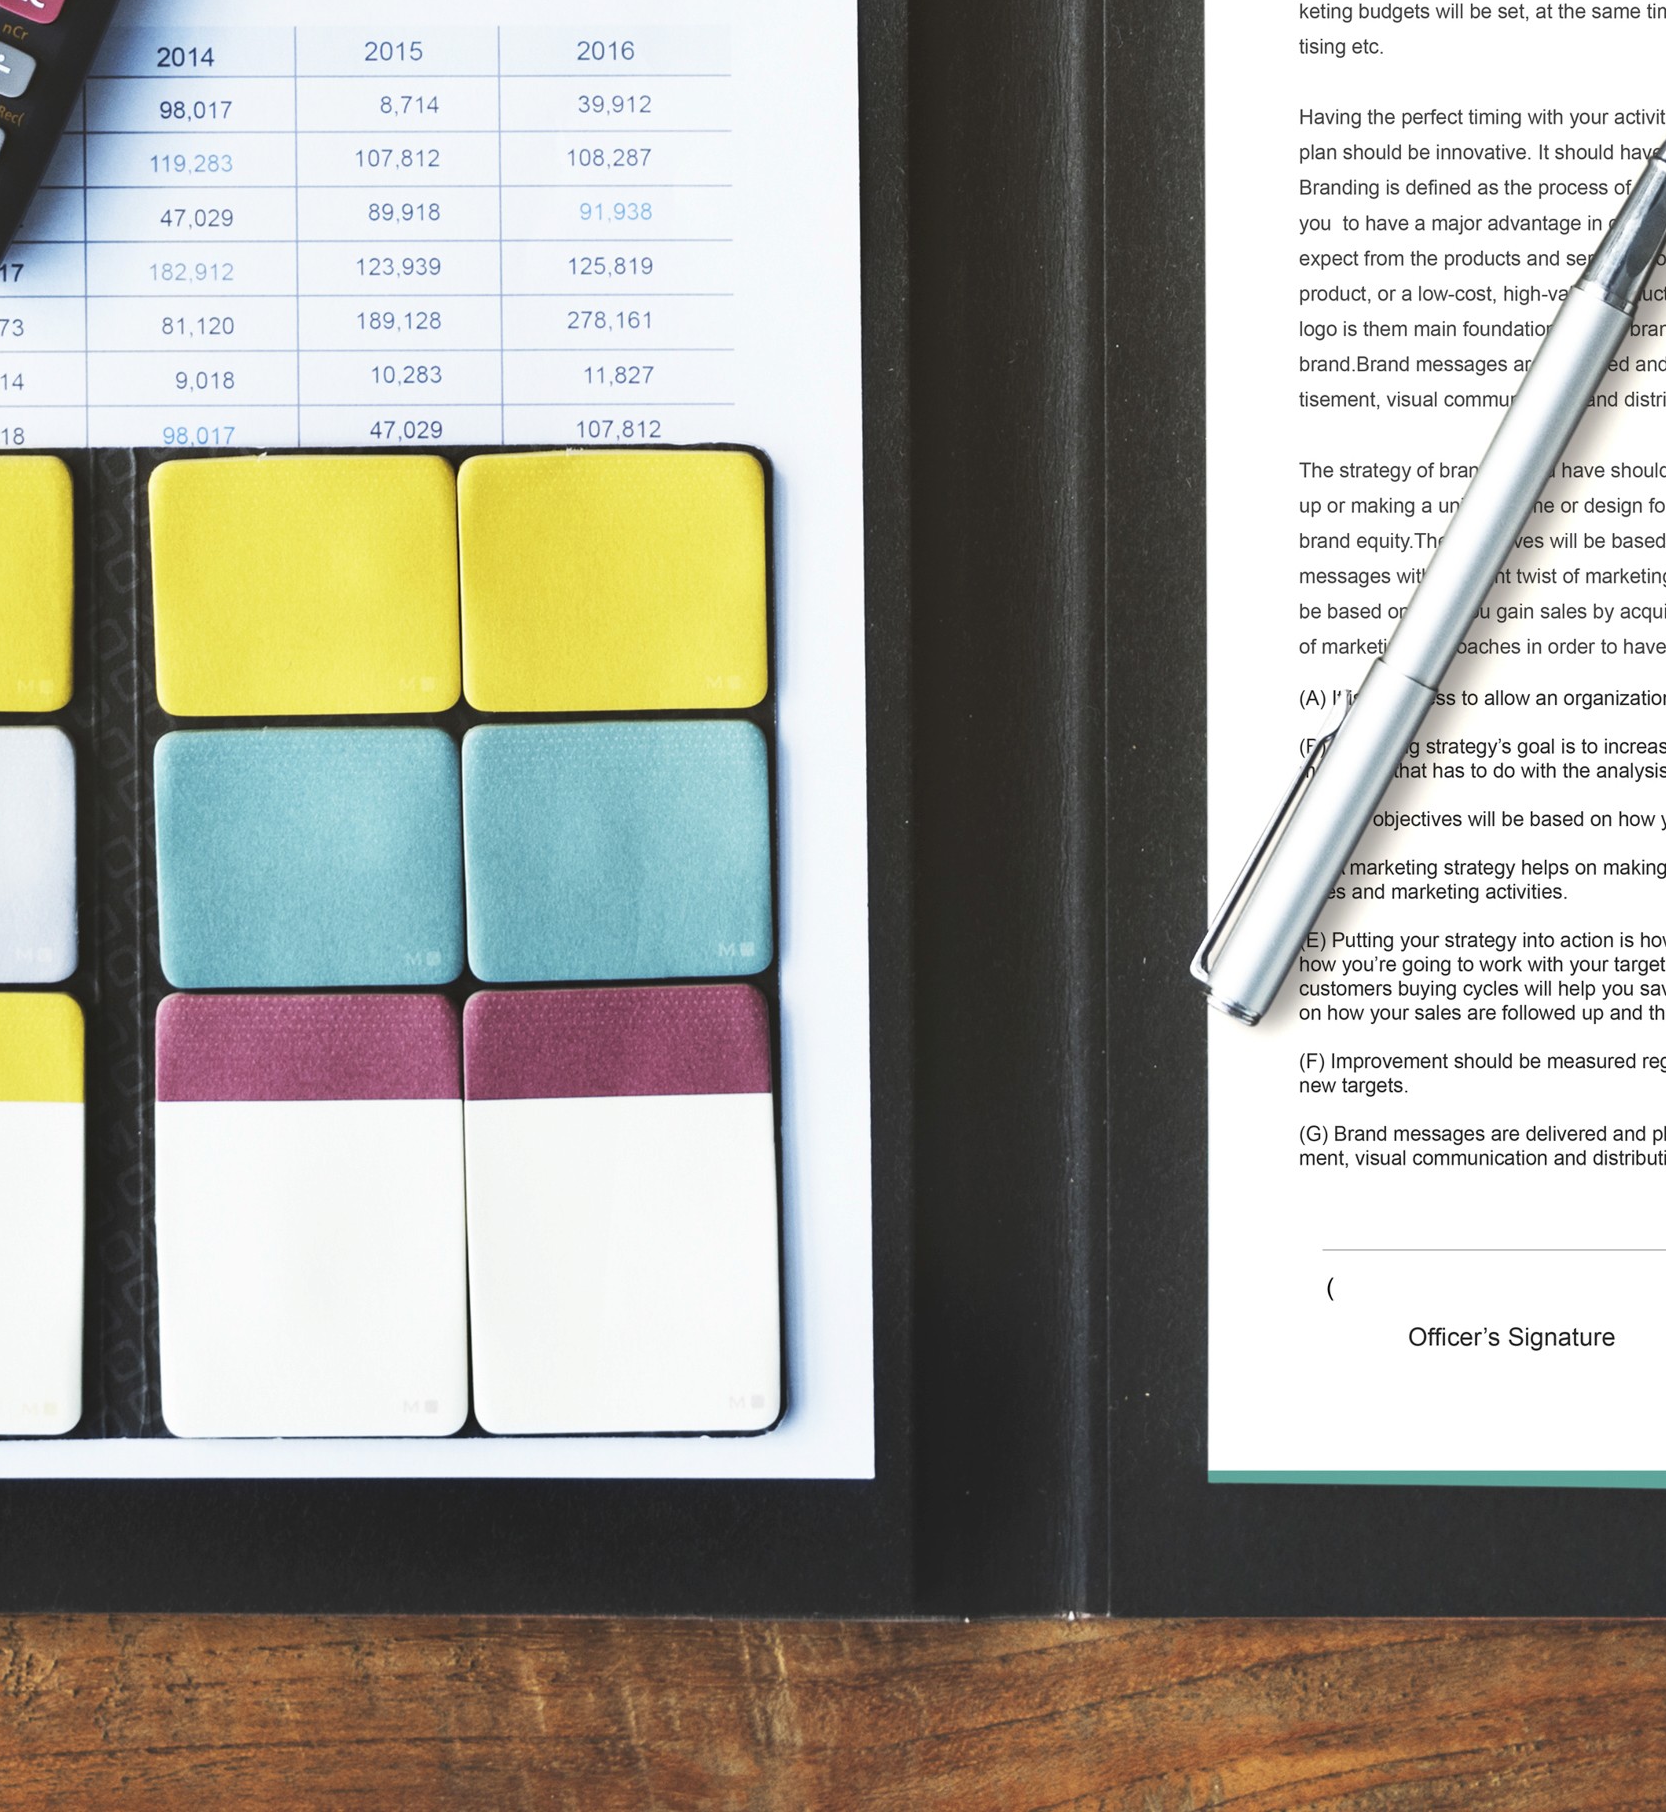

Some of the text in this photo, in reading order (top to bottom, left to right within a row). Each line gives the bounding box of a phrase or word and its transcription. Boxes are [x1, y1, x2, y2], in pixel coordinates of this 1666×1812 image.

[157, 40, 635, 67] 2014 2015 2016
[159, 95, 651, 122] 98,017 8,714 39,912
[150, 154, 234, 175] 119,283
[356, 149, 440, 170] 107,812
[567, 148, 651, 169] 108,287
[160, 209, 234, 230] 47,029
[368, 202, 440, 224] 89,918
[580, 202, 652, 224] 91,938
[150, 263, 235, 284] 182,912
[356, 257, 441, 278] 123,939
[568, 256, 653, 277] 125,819
[162, 317, 235, 338] 81,120
[357, 311, 442, 332] 189,128
[567, 311, 652, 332] 278,161
[175, 371, 235, 393] 9,018
[371, 365, 442, 386] 10,283
[583, 365, 654, 387] 11,827
[163, 426, 236, 446] 98,017
[370, 420, 443, 442] 47,029
[576, 420, 662, 441] 107,812
[1373, 811, 1461, 830] objectives
[1468, 811, 1494, 826] will
[1503, 811, 1523, 826] be
[1531, 811, 1583, 826] based
[1591, 815, 1611, 826] on
[1620, 811, 1655, 826] how
[1409, 1327, 1615, 1351] Officer’s Signature
